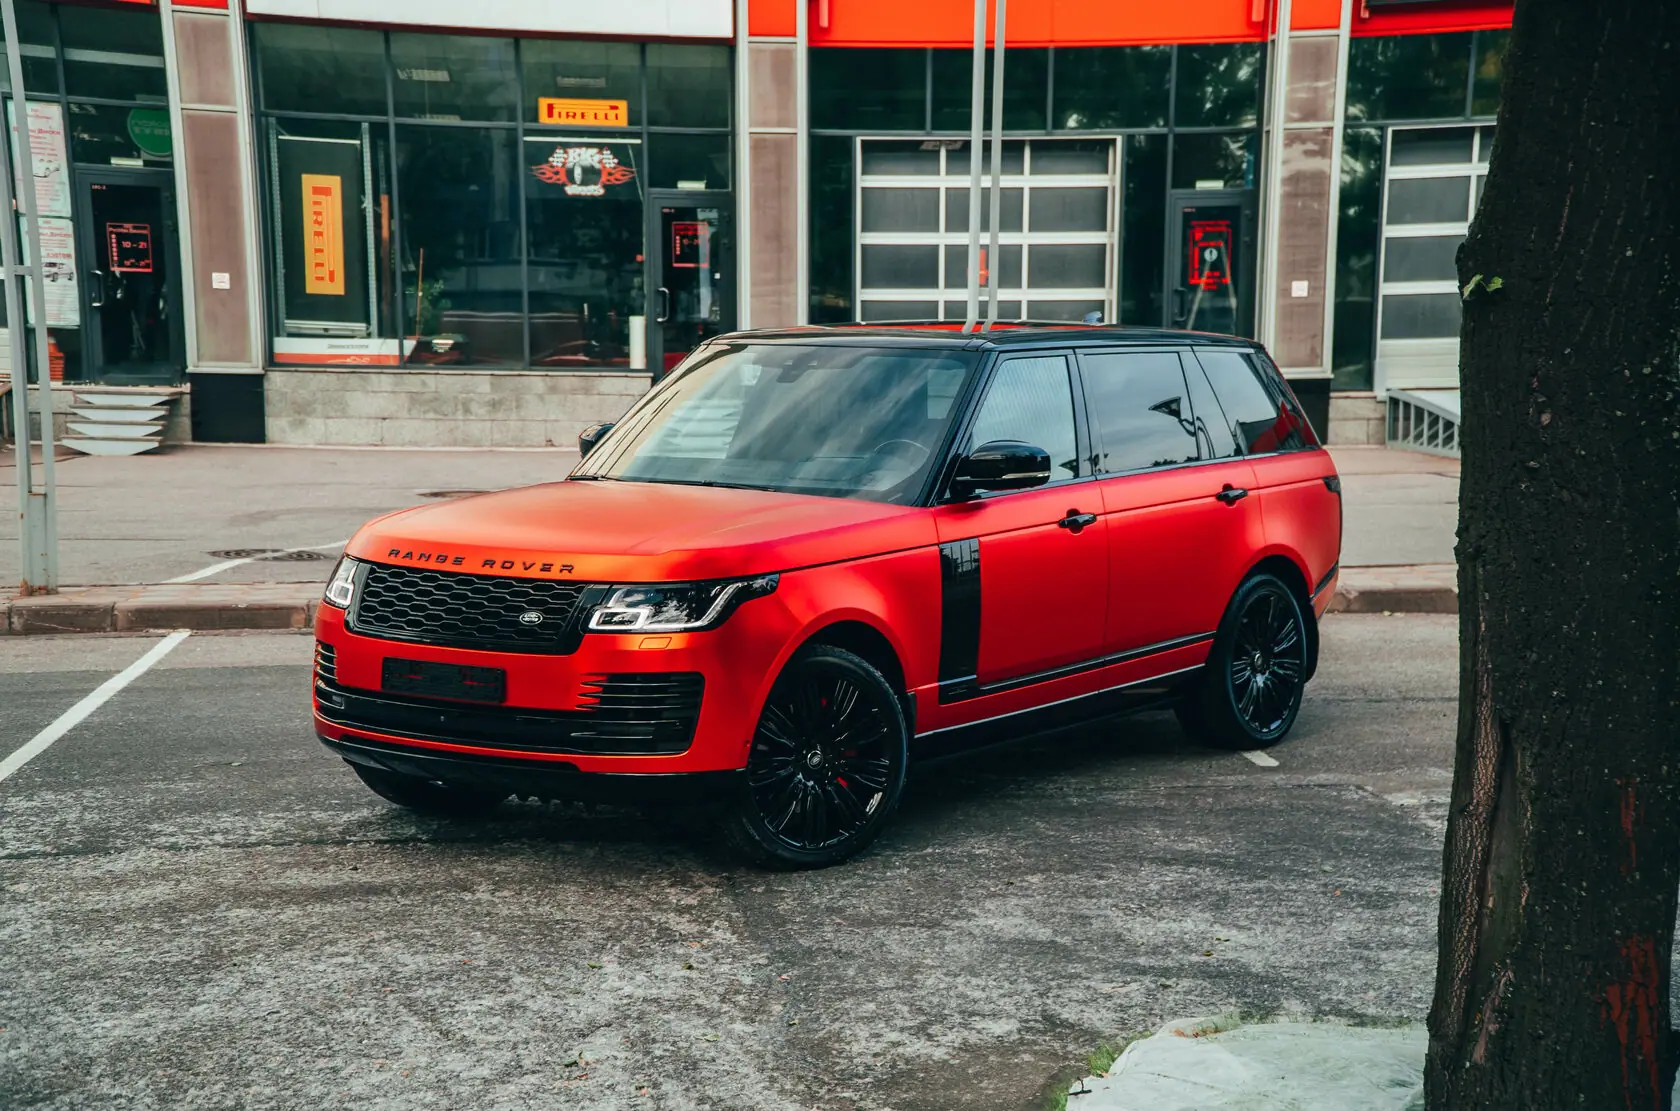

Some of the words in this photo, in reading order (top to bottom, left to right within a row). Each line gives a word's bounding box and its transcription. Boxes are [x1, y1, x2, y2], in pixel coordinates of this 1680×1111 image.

[547, 103, 619, 120] PIRELLI
[311, 186, 335, 283] PIRELLI
[388, 548, 466, 566] RANGE
[481, 559, 575, 574] ROVER
